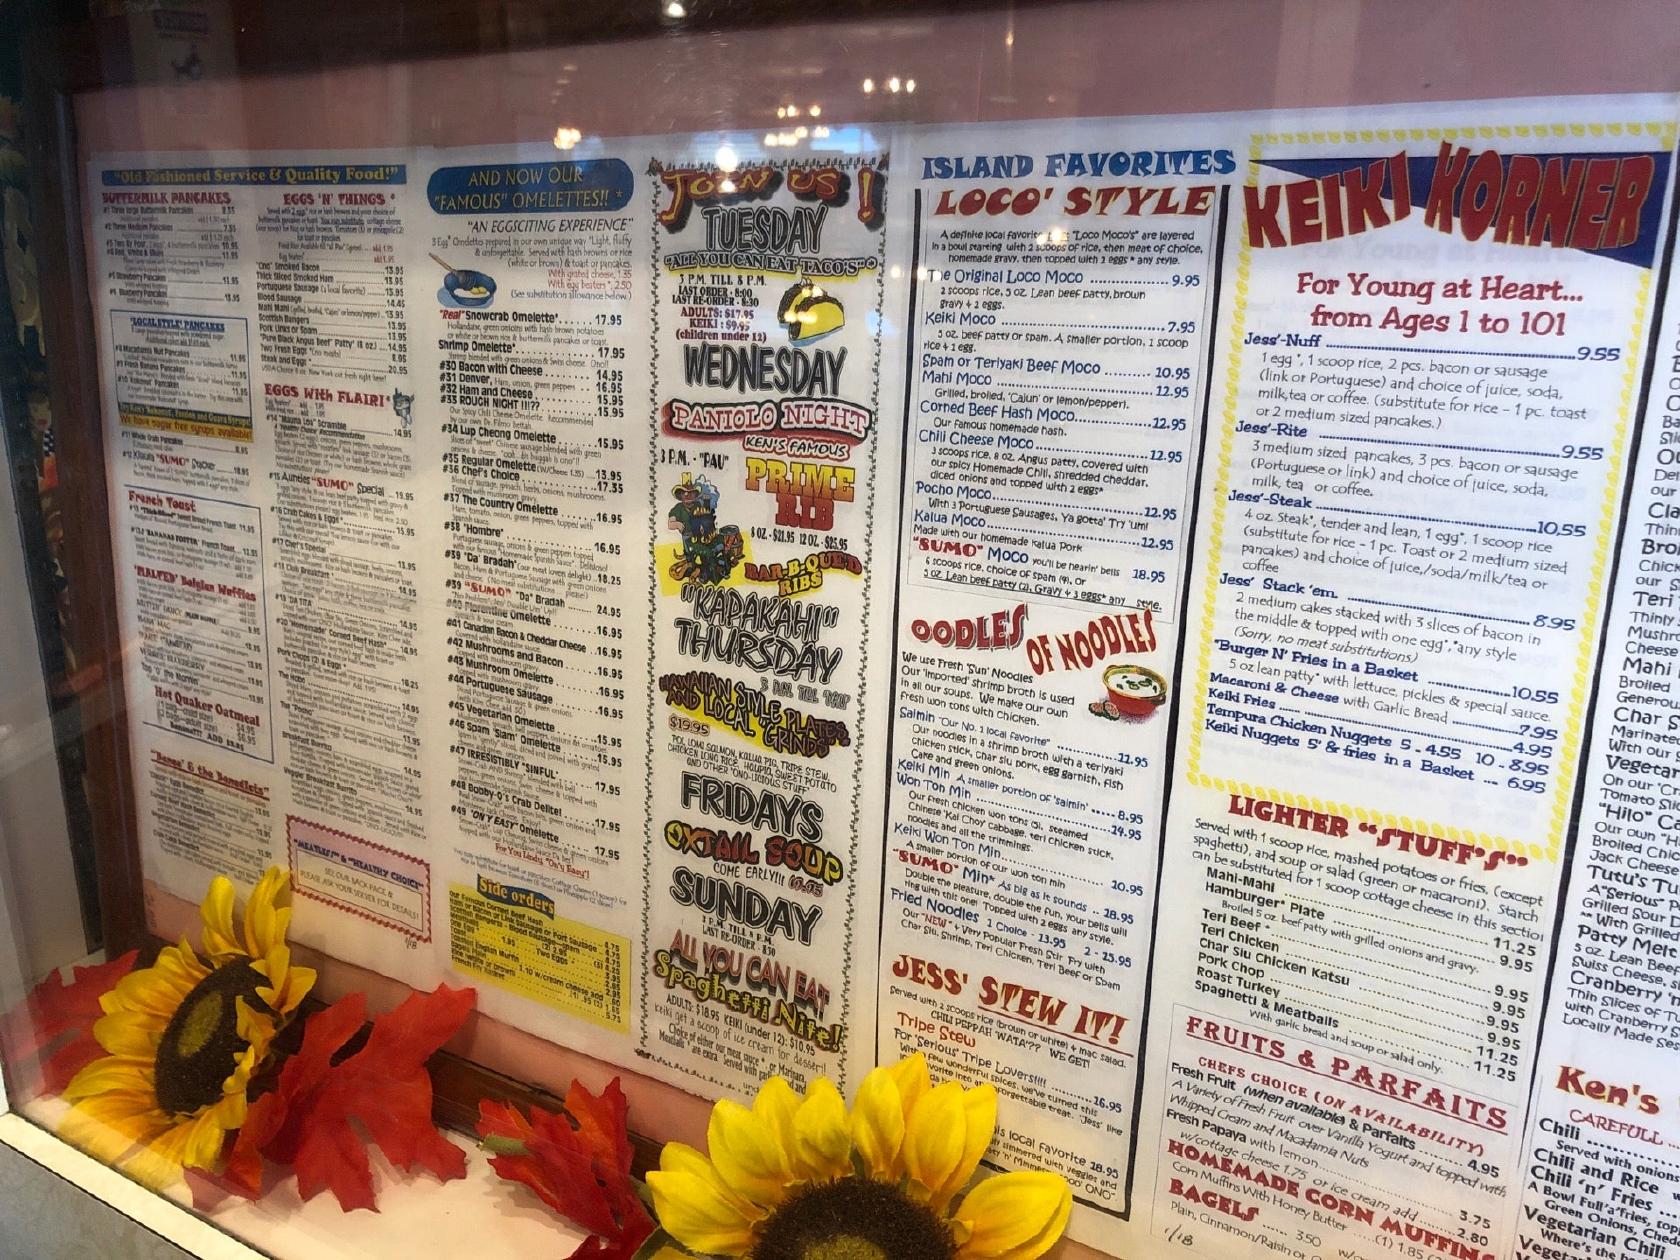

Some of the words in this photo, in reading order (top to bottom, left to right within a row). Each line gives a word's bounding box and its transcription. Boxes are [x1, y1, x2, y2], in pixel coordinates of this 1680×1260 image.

[146, 170, 211, 183] Fashioned
[213, 170, 266, 182] Service
[269, 169, 281, 181] &
[286, 168, 340, 183] Quality
[469, 170, 500, 186] AND
[505, 169, 544, 185] NOW
[548, 167, 583, 183] OUR
[922, 154, 1034, 180] ISLAND
[1044, 150, 1236, 177] FAVORITES
[171, 192, 231, 205] PANCAKES
[283, 193, 310, 205] EGGS
[338, 193, 386, 205] THINGS
[512, 191, 609, 208] OMELETTES!!
[1064, 185, 1216, 216] STYLE
[1242, 150, 1411, 248] KEIKI
[1424, 139, 1655, 251] KORNER
[491, 220, 555, 232] EGGSCITING
[701, 205, 827, 254] TUESDAY
[699, 252, 729, 267] YOU
[732, 254, 763, 270] CAN
[765, 256, 797, 272] EAT
[955, 269, 1003, 284] Original
[1007, 270, 1041, 284] Loco
[1045, 269, 1083, 284] Moco
[1172, 275, 1200, 287] 9.95
[1297, 272, 1340, 295] For
[1347, 274, 1434, 305] Young
[1442, 279, 1472, 299] at
[595, 315, 622, 325] 17.95
[925, 312, 956, 325] Keiki
[959, 313, 996, 326] Moco
[1167, 322, 1195, 334] 7.95
[1311, 306, 1372, 328] from
[1379, 308, 1450, 338] Ages
[1479, 313, 1510, 335] to
[1520, 312, 1566, 336] 101
[439, 340, 469, 351] Shrimp
[598, 348, 625, 359] 17.95
[1576, 347, 1620, 362] 9.55
[459, 362, 485, 372] Bacon
[487, 364, 507, 374] with
[510, 364, 543, 375] Cheese
[596, 370, 623, 381] 14.95
[683, 341, 848, 397] WEDNESDAY
[1292, 370, 1306, 384] or
[1390, 377, 1413, 393] and
[1417, 380, 1462, 396] choice
[264, 383, 299, 398] EGGS
[673, 403, 776, 430] PANIOLO
[782, 401, 866, 435] NIGHT
[745, 435, 785, 452] KEN'S
[787, 440, 849, 458] FAMOUS
[746, 457, 855, 501] PRIME
[128, 490, 163, 508] French
[775, 493, 834, 531] RIB
[773, 530, 794, 543] $21.95
[824, 536, 848, 550] $25.95
[987, 547, 1029, 564] Moco
[1132, 569, 1165, 583] 18.95
[778, 571, 822, 596] RIBS
[675, 618, 843, 684] THURSDAY
[1025, 634, 1055, 676] OF
[1056, 609, 1157, 671] NOODLES
[466, 678, 514, 696] Portuguese
[517, 689, 553, 704] Sausage
[598, 706, 624, 719] 16.95
[1210, 673, 1271, 692] Macaroni
[1274, 681, 1287, 693] &
[1291, 685, 1339, 703] Cheese
[154, 686, 172, 701] Hot
[175, 692, 213, 712] Quaker
[215, 705, 260, 727] Oatmeal
[680, 770, 823, 843] FRIDAYS
[1228, 794, 1349, 839] LIGHTER
[664, 820, 759, 864] OXTAIL
[765, 835, 843, 885] SOUP
[479, 877, 507, 897] Side
[512, 891, 554, 914] orders
[669, 866, 823, 947] SUNDAY
[1206, 868, 1275, 893] Mahi-Mahi
[1493, 937, 1536, 957] 11.25
[1578, 924, 1628, 947] Patty
[1634, 937, 1677, 958] Melt
[670, 929, 698, 963] ALL
[703, 942, 744, 976] YOU
[747, 955, 791, 994] CAN
[795, 970, 830, 1010] EAT
[1197, 967, 1234, 986] Roast
[1236, 975, 1280, 999] Turkey
[654, 949, 770, 1023] Spaghetti
[775, 999, 843, 1053] Nite!
[978, 975, 1068, 1026] STEW
[1073, 1005, 1130, 1044] IT!
[897, 1011, 935, 1034] Tripe
[940, 1026, 975, 1049] Stew
[1093, 1095, 1122, 1113] 16.95
[1186, 1016, 1285, 1058] FRUITS
[1298, 1050, 1315, 1067] &
[1331, 1058, 1507, 1129] PARFAITS
[1556, 1065, 1660, 1115] Ken's
[1539, 1118, 1580, 1140] Chili
[1570, 1109, 1663, 1145] CAREFULL
[1168, 1139, 1299, 1198] HOMEMADE
[1305, 1189, 1373, 1225] CORN
[1467, 1158, 1499, 1178] 4.95
[1534, 1148, 1575, 1171] Chili
[1580, 1163, 1613, 1182] and
[1621, 1172, 1659, 1194] Rice
[1169, 1178, 1259, 1223] BAGELS
